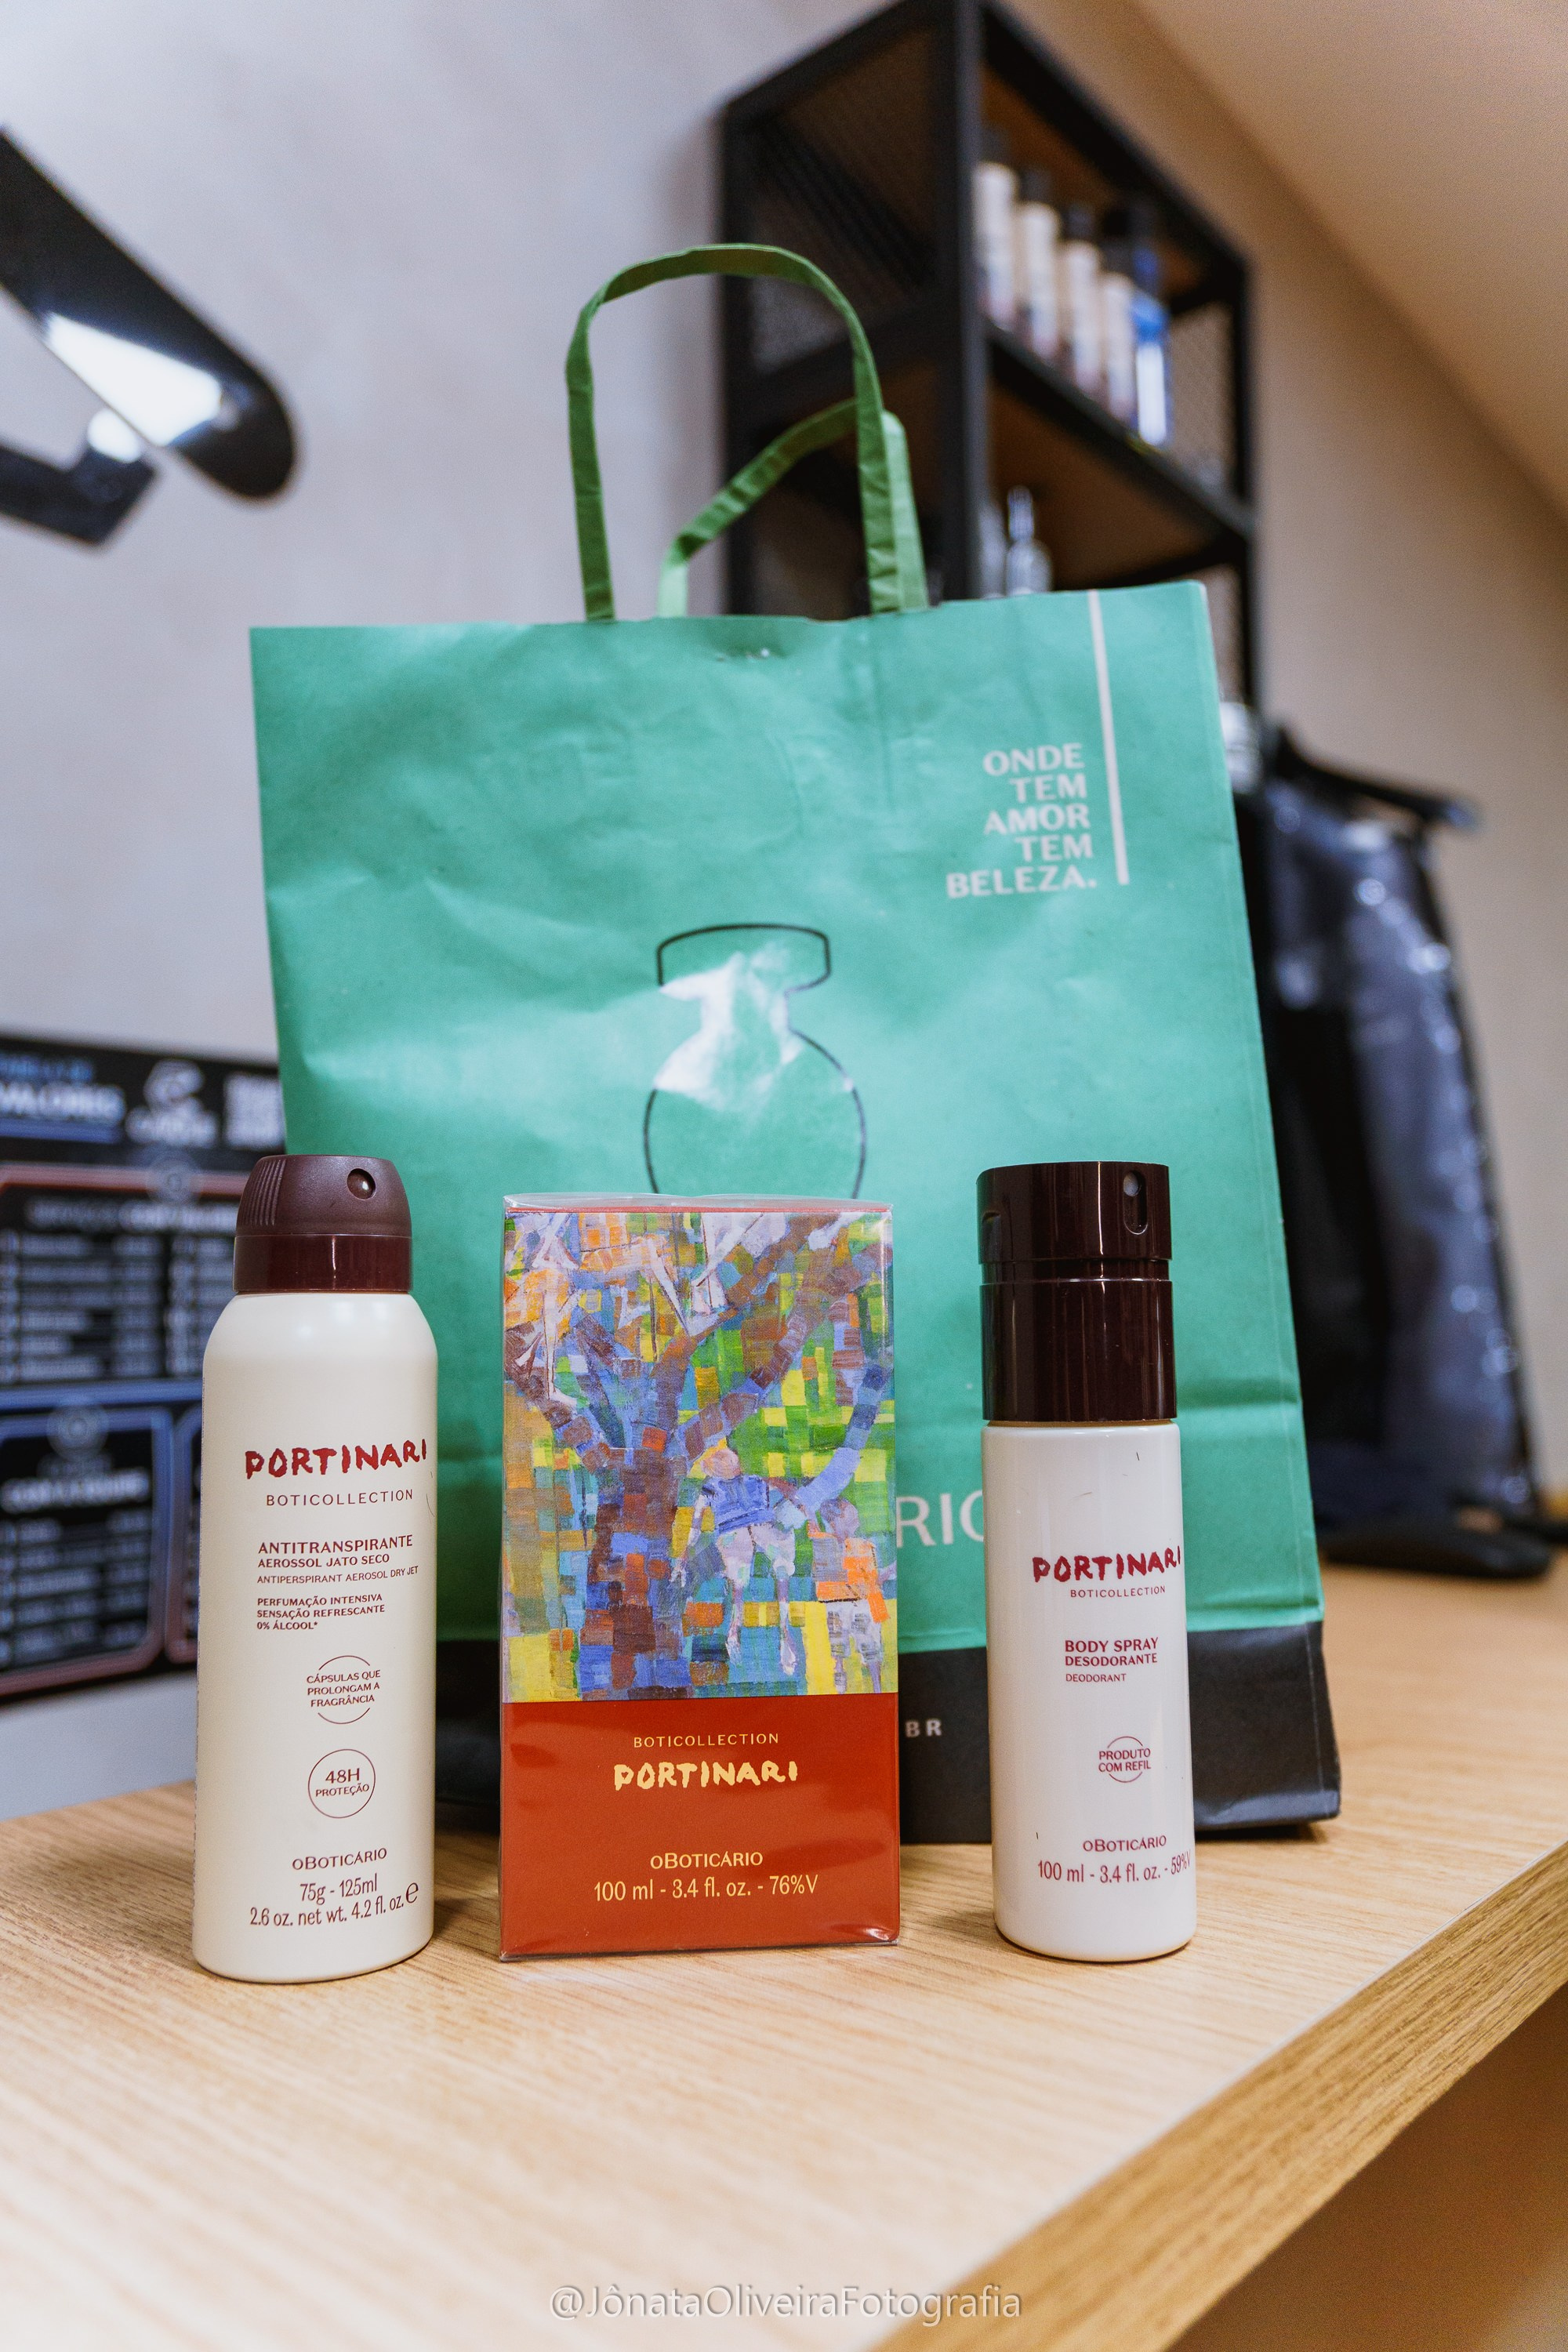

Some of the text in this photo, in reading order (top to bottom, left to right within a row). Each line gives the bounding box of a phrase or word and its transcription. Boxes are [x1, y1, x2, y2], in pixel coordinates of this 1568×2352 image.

[982, 742, 1085, 777] ONDE
[1009, 772, 1087, 804] TEM
[984, 803, 1091, 837] AMOR
[1013, 833, 1094, 862] TEM
[946, 864, 1098, 899] BELEZA.
[245, 1438, 427, 1480] PORTINARI
[266, 1489, 412, 1507] BOTICOLLECTION
[258, 1534, 413, 1555] ANTITRANSPIRANTE
[257, 1553, 390, 1568] AEROSSOL JATO SECO
[1032, 1545, 1181, 1583] PORTINARI
[256, 1565, 419, 1584] ANTIPERSPIRANT AEROSOL DRY JET
[1070, 1585, 1166, 1599] BOTICOLLECTION
[257, 1593, 383, 1609] PERFUMAÇÃO INTENSIVA
[256, 1604, 385, 1621] SENSAÇÃO REFRESCANTE
[256, 1621, 270, 1630] 0%
[1065, 1637, 1159, 1653] BODY SPRAY
[1065, 1653, 1158, 1667] DESODORANTE
[306, 1669, 381, 1684] CÁPSULAS QUE
[1065, 1673, 1127, 1683] DEODORANT
[307, 1682, 380, 1697] PROLONGAM A
[310, 1694, 375, 1708] FRAGRÂNCIA
[633, 1733, 779, 1748] BOTICOLLECTION
[1098, 1748, 1151, 1761] PRODUTO
[1098, 1759, 1152, 1773] COM REFIL
[325, 1767, 360, 1784] 48H
[613, 1760, 798, 1791] PORTINARI
[315, 1782, 370, 1798] PROTEÇÃO
[1037, 1860, 1062, 1881] 100
[1066, 1864, 1084, 1882] ml
[1099, 1864, 1122, 1884] 3.4
[1125, 1863, 1139, 1882] fl.
[1143, 1866, 1161, 1881] oz.
[299, 1882, 326, 1906] 75g
[339, 1872, 377, 1897] 125ml
[593, 1881, 626, 1902] 100
[633, 1878, 653, 1900] ml
[672, 1878, 699, 1899] 3.4
[703, 1876, 720, 1897] fl.
[726, 1882, 751, 1897] oz.
[769, 1874, 818, 1895] 76%V
[250, 1907, 270, 1926] 2.6
[273, 1913, 293, 1926] oz.
[298, 1908, 322, 1926] net
[325, 1906, 347, 1923] wt.
[350, 1899, 372, 1919] 4.2
[375, 1895, 387, 1915] fl.
[389, 1895, 405, 1911] oz.
